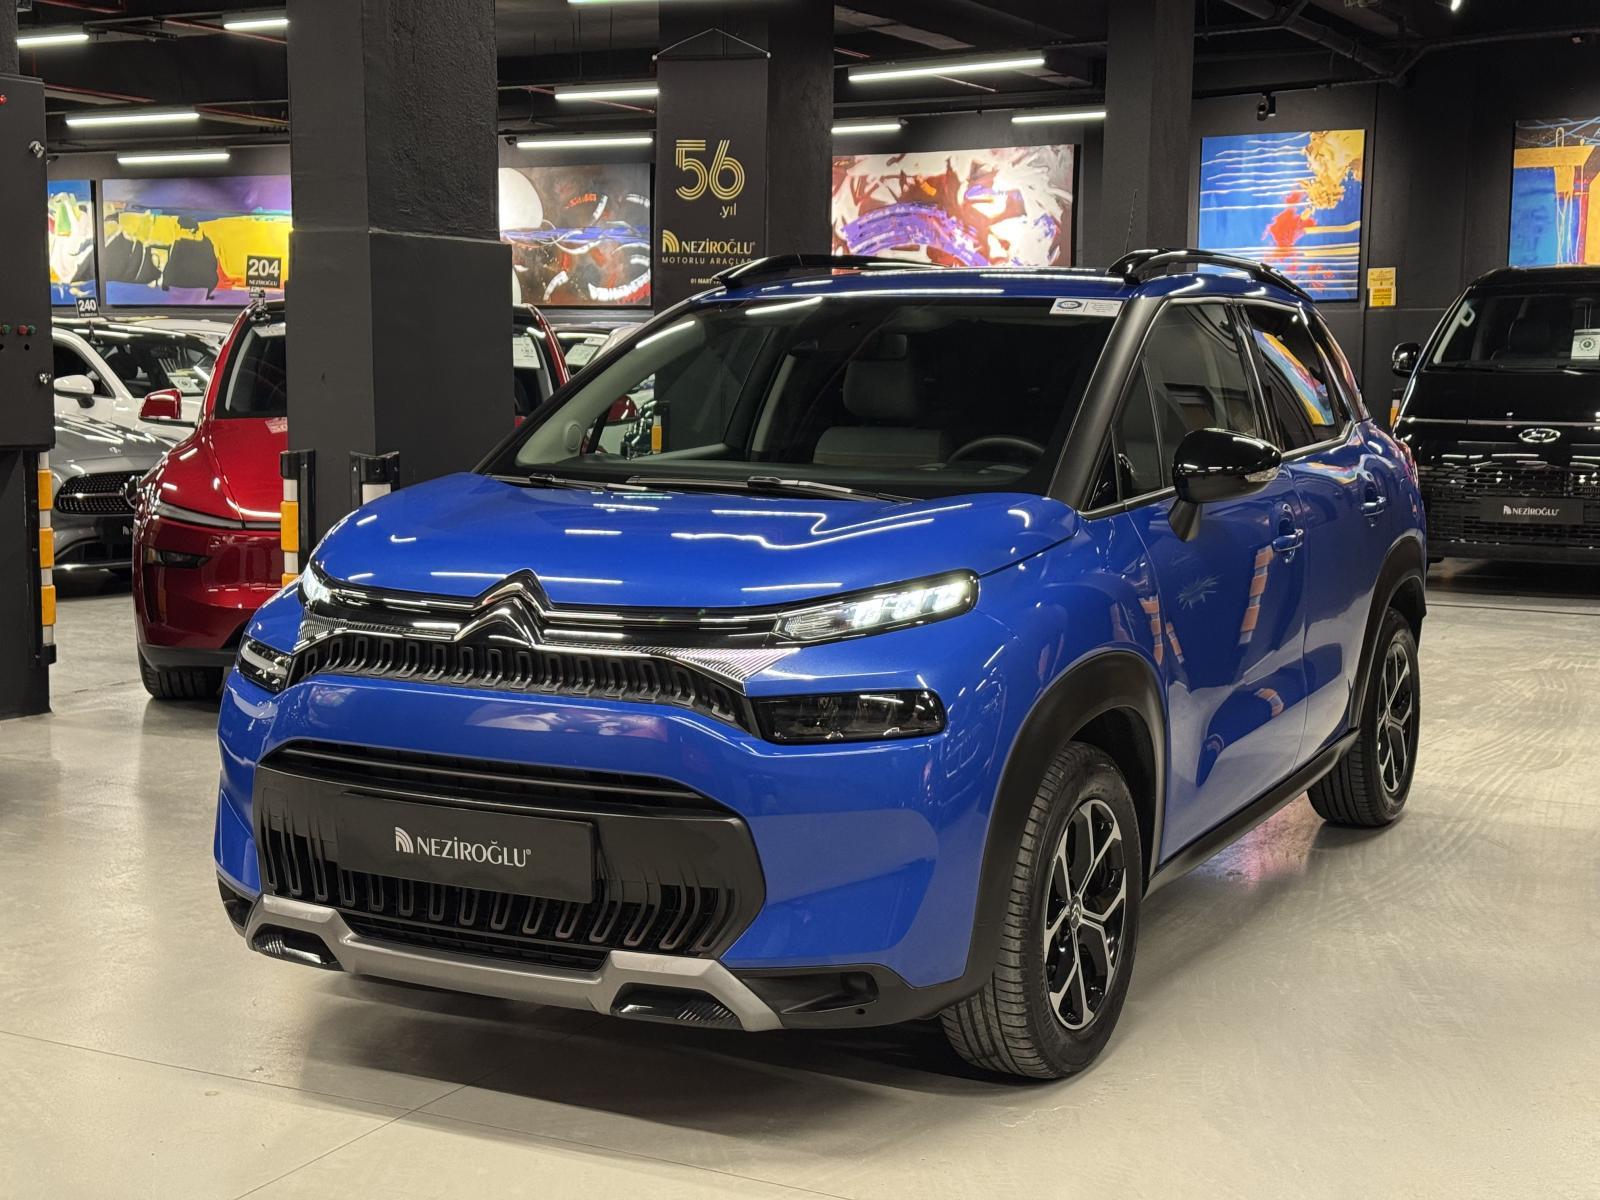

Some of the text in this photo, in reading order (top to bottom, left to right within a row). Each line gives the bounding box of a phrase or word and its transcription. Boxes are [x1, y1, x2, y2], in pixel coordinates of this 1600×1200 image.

[676, 139, 745, 200] 56
[681, 237, 753, 255] NEZİROĞLU
[247, 258, 280, 277] 204
[661, 256, 705, 265] MOTORLU
[78, 299, 97, 312] 240
[1512, 506, 1558, 516] NEZİROĞLU
[416, 836, 527, 868] NEZİROĞLU
